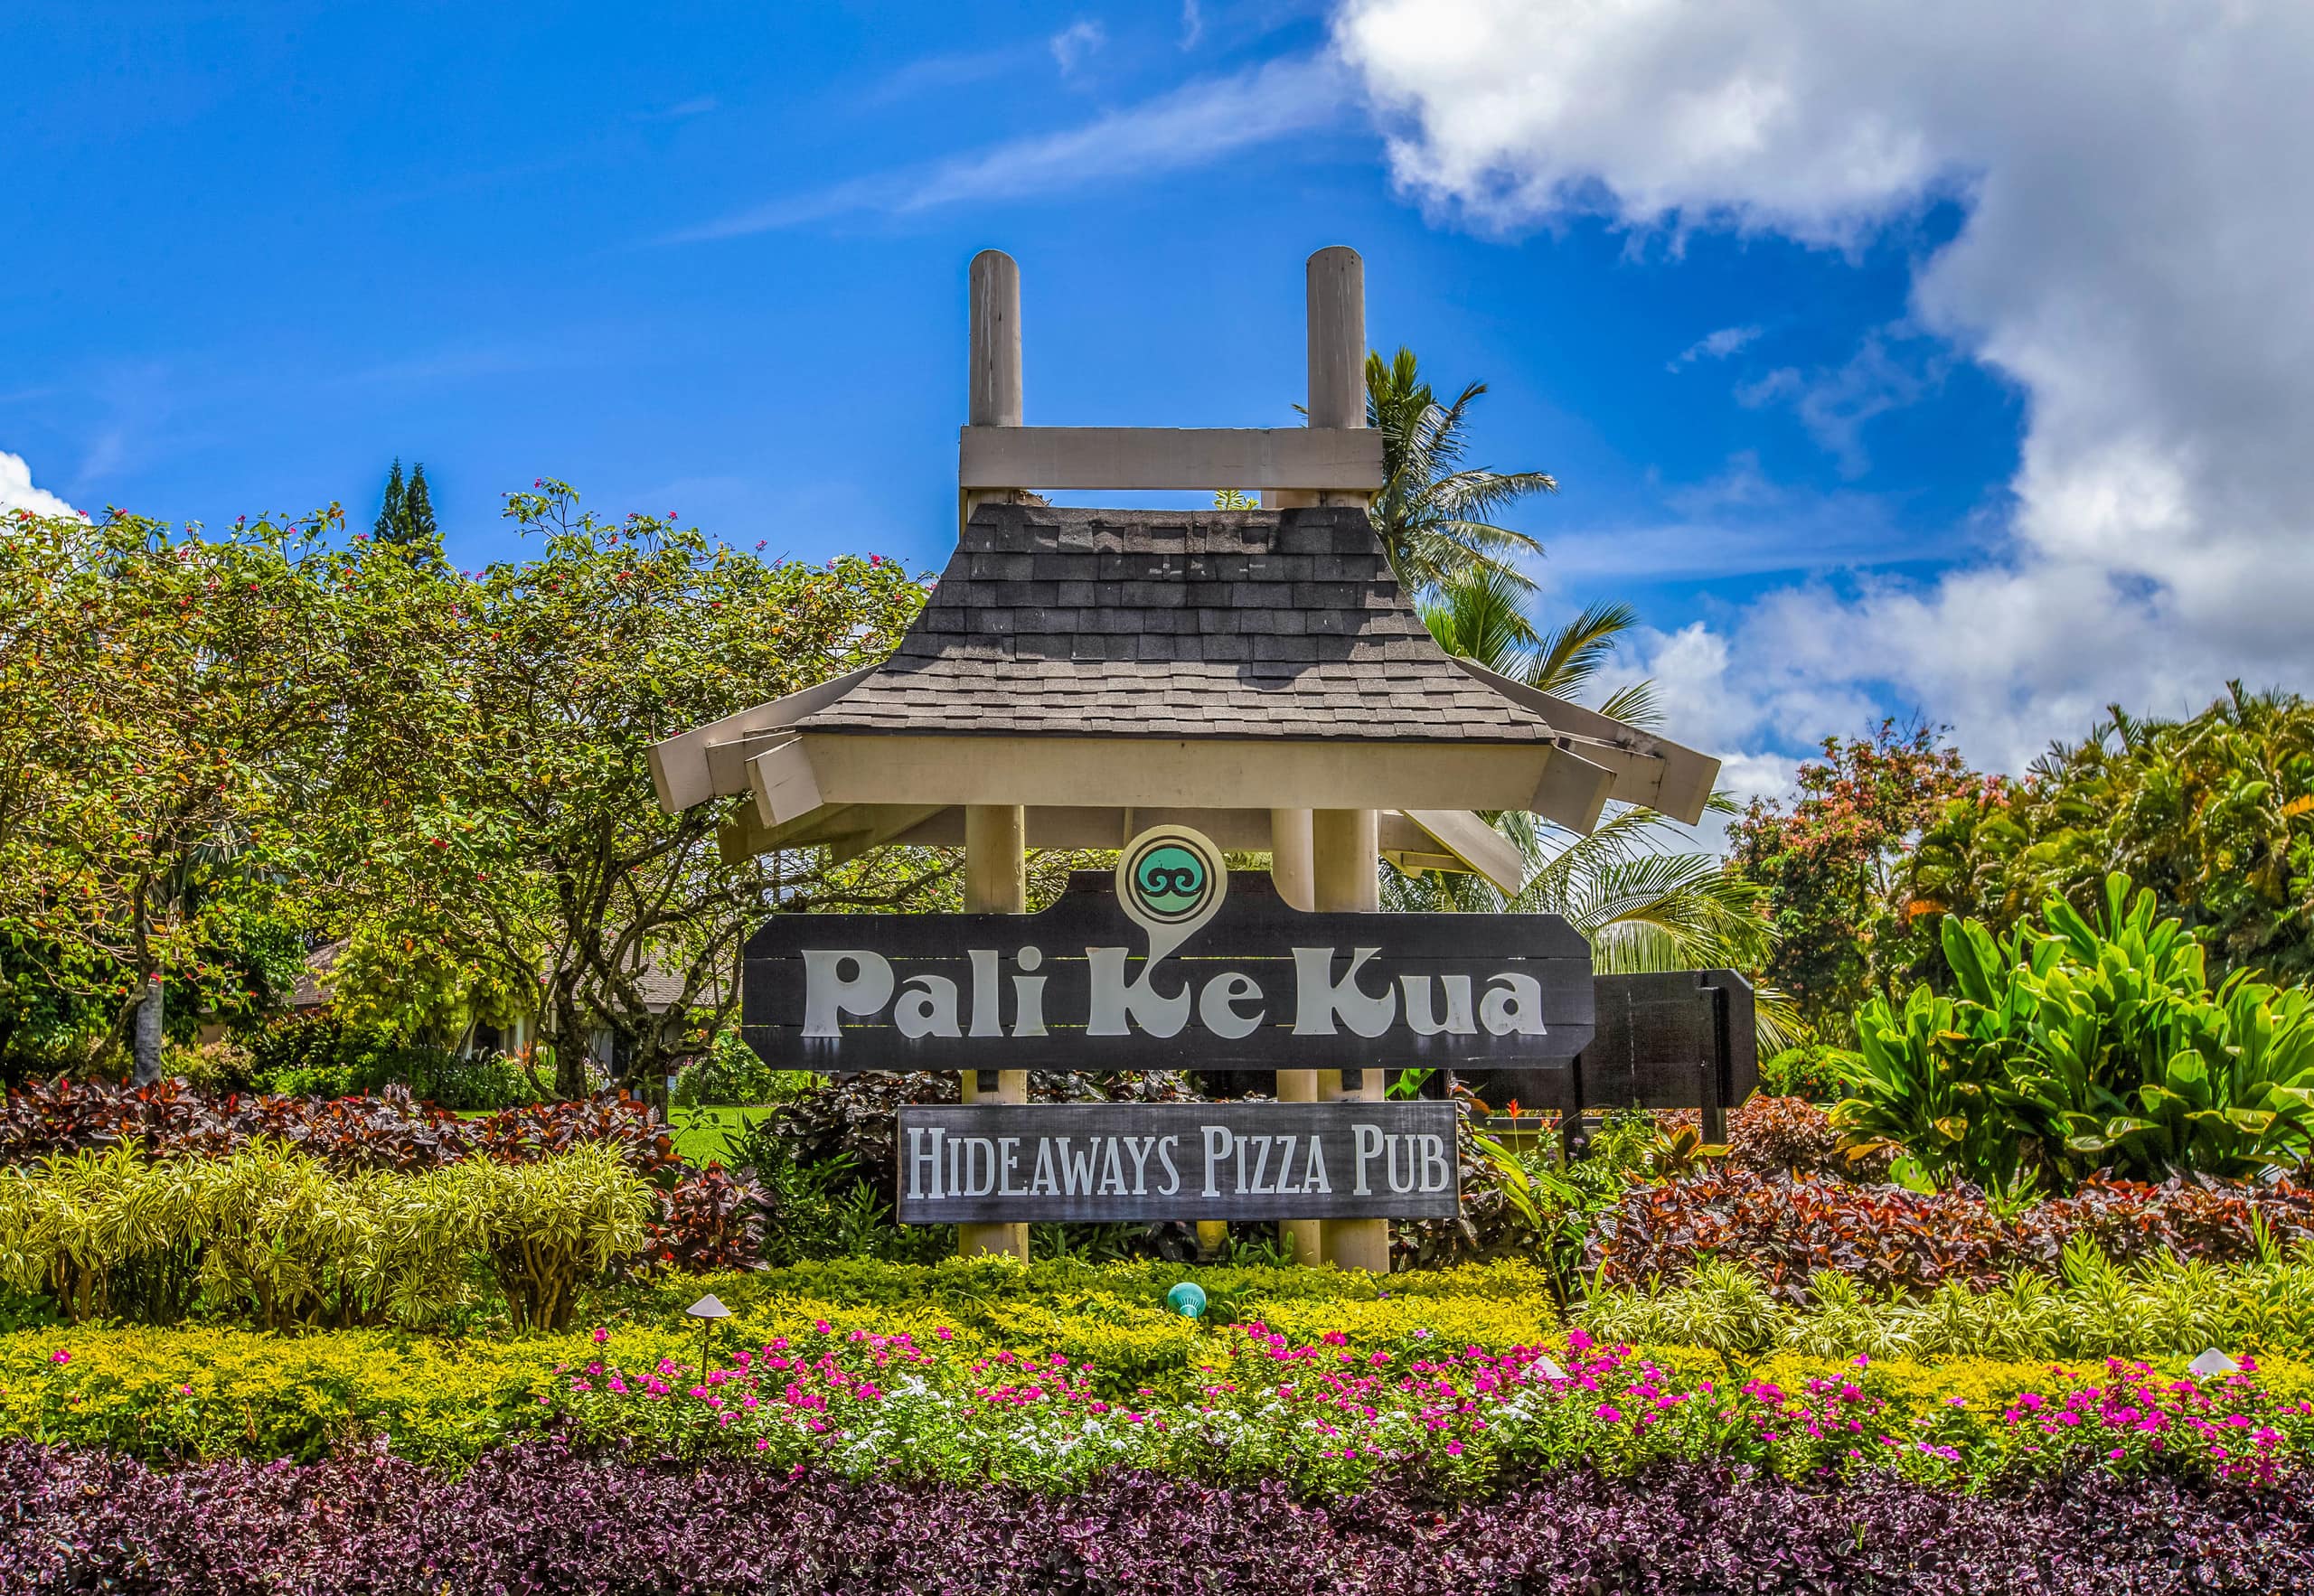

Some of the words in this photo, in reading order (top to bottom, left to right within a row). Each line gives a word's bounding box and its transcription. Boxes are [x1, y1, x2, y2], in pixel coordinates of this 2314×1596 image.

[800, 945, 1049, 1039] Pali
[1086, 927, 1265, 1039] Ke
[1291, 946, 1547, 1038] Kua
[1200, 1125, 1332, 1197] PIZZA
[1351, 1123, 1450, 1197] PUB
